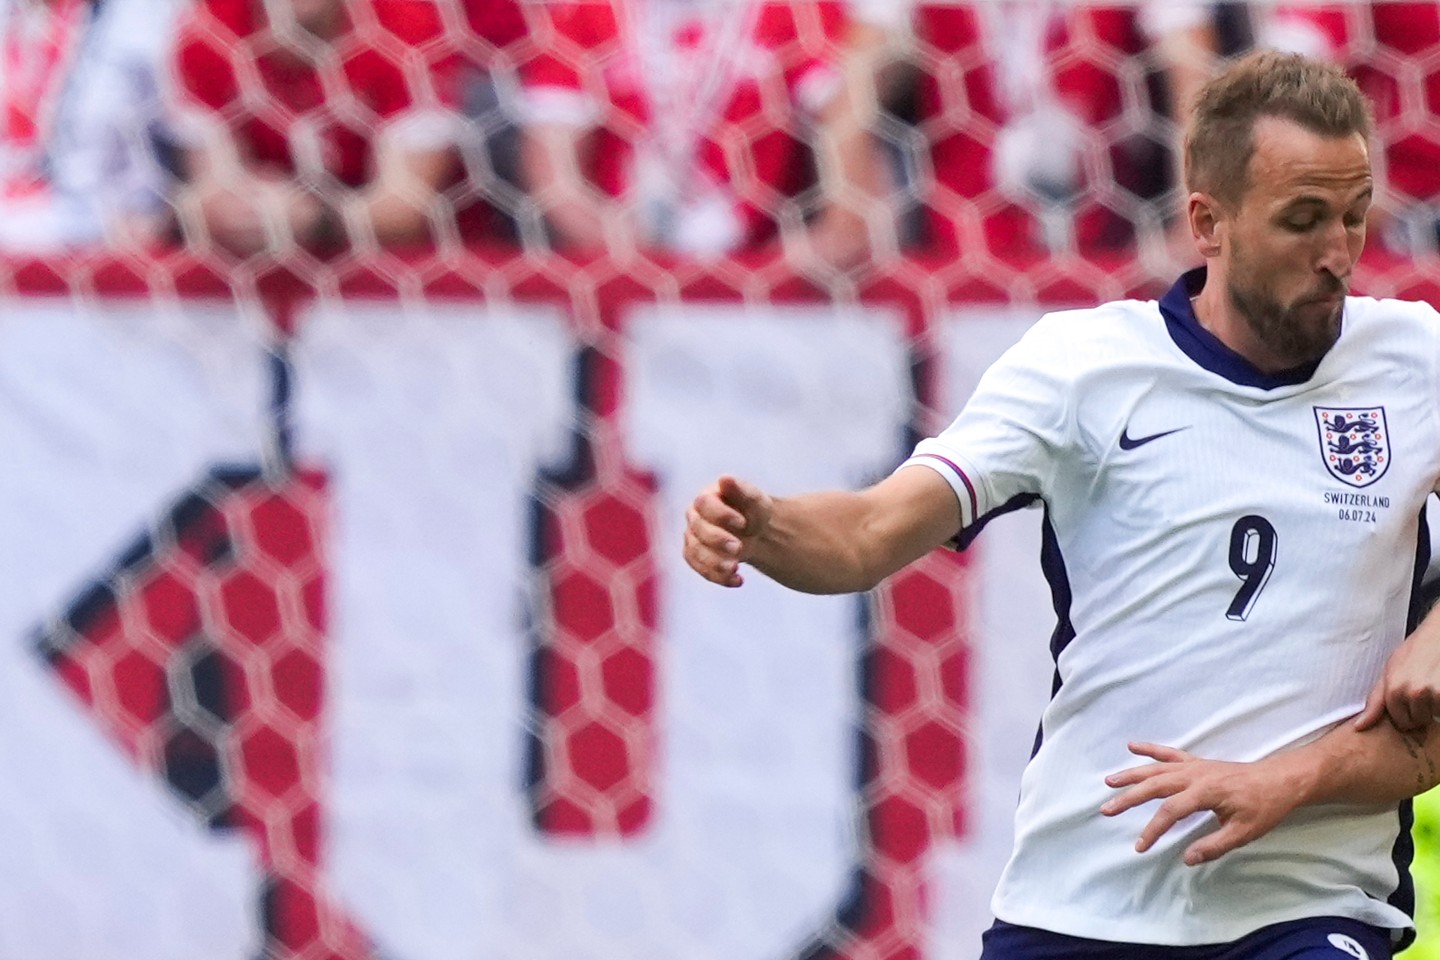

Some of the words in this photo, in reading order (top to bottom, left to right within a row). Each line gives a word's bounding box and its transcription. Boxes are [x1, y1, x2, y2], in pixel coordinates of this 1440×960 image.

[1324, 491, 1390, 509] SWITZERLAND
[1338, 509, 1377, 523] 06.07.24
[1225, 514, 1278, 622] 9
